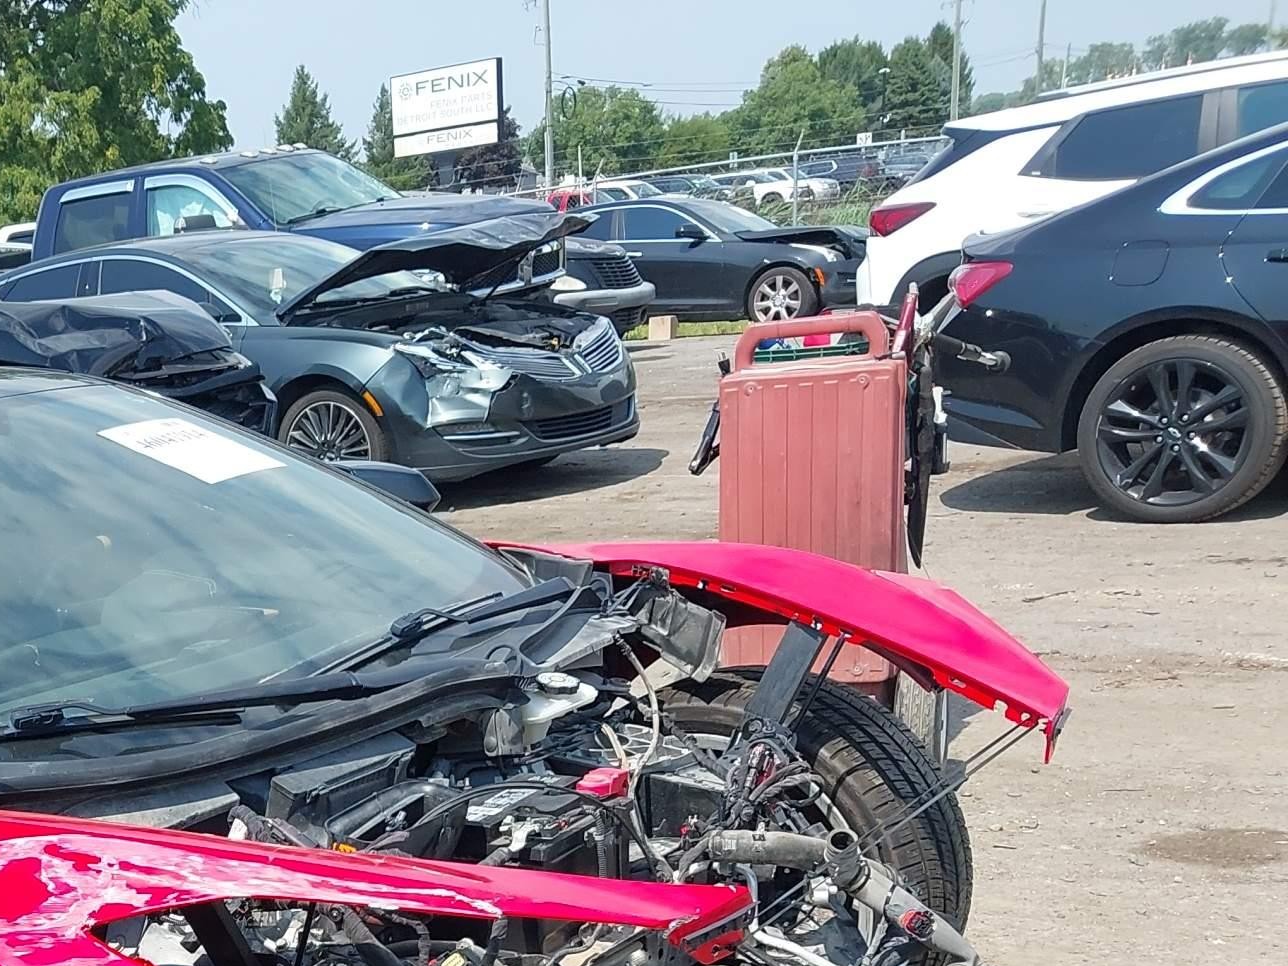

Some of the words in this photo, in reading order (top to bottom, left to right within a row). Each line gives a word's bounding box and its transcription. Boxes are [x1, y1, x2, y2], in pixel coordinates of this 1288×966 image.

[415, 70, 488, 95] FENIX
[430, 98, 458, 109] FENIX
[460, 91, 493, 103] PARTS
[397, 111, 436, 126] DETROIT
[440, 106, 472, 119] SOUTH
[475, 103, 493, 113] LLC
[427, 128, 472, 144] FENIX
